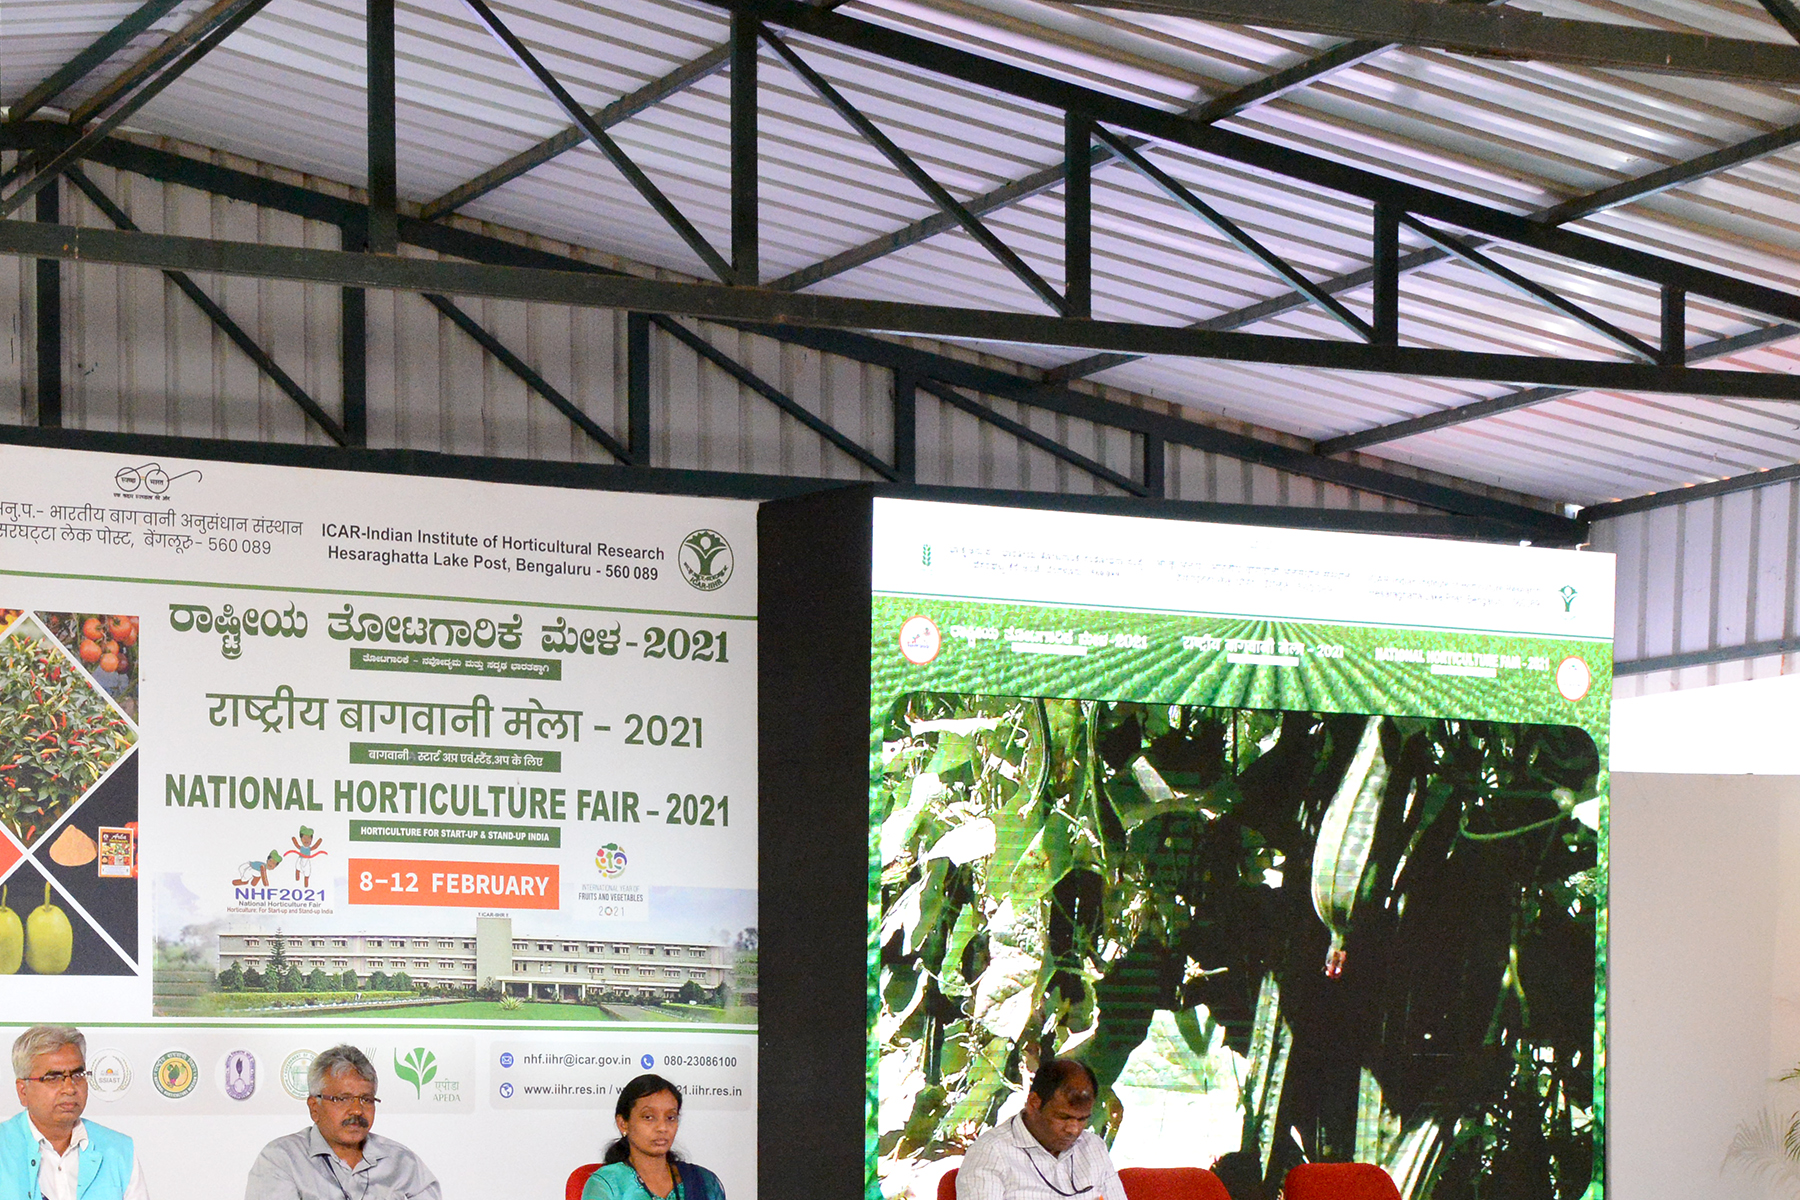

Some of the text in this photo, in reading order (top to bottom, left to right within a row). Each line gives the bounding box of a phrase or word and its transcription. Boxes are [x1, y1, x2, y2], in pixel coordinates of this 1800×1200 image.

[50, 503, 106, 523] भारतीय
[180, 512, 249, 534] अनुसंधान
[252, 516, 304, 536] संस्थान
[60, 524, 93, 543] लेक
[208, 537, 238, 553] 560
[241, 539, 271, 555] 089
[322, 523, 665, 561] ICAR-Indian Institute of Horticultural Research
[328, 545, 658, 581] Hesaraghatta Lake Post, Bengaluru 560 089
[168, 599, 308, 660] ರಾಷ್ಟ್ರೀಯ
[327, 603, 523, 650] ತೋಟಗಾರಿಕೆ
[205, 684, 329, 734] राष्ट्रीय
[336, 694, 495, 738] बागवानी
[624, 713, 703, 749] 2021
[165, 773, 729, 827] NATIONAL HORTICULTURE FAIR 2021
[360, 826, 550, 842] HORTICULTURE FOR START-UP & STAND-UP INDIA
[432, 873, 550, 896] FEBRUARY
[235, 887, 325, 902] NHF2021
[578, 892, 644, 902] FRUITS AND VEGETABLES
[523, 1053, 632, 1068] nhf.iihr@icar.gov.in
[663, 1055, 737, 1068] 080-23086100
[434, 1078, 460, 1093] एपीडा
[523, 1084, 606, 1096] www.iihr.res.in
[432, 1094, 462, 1102] APEDA
